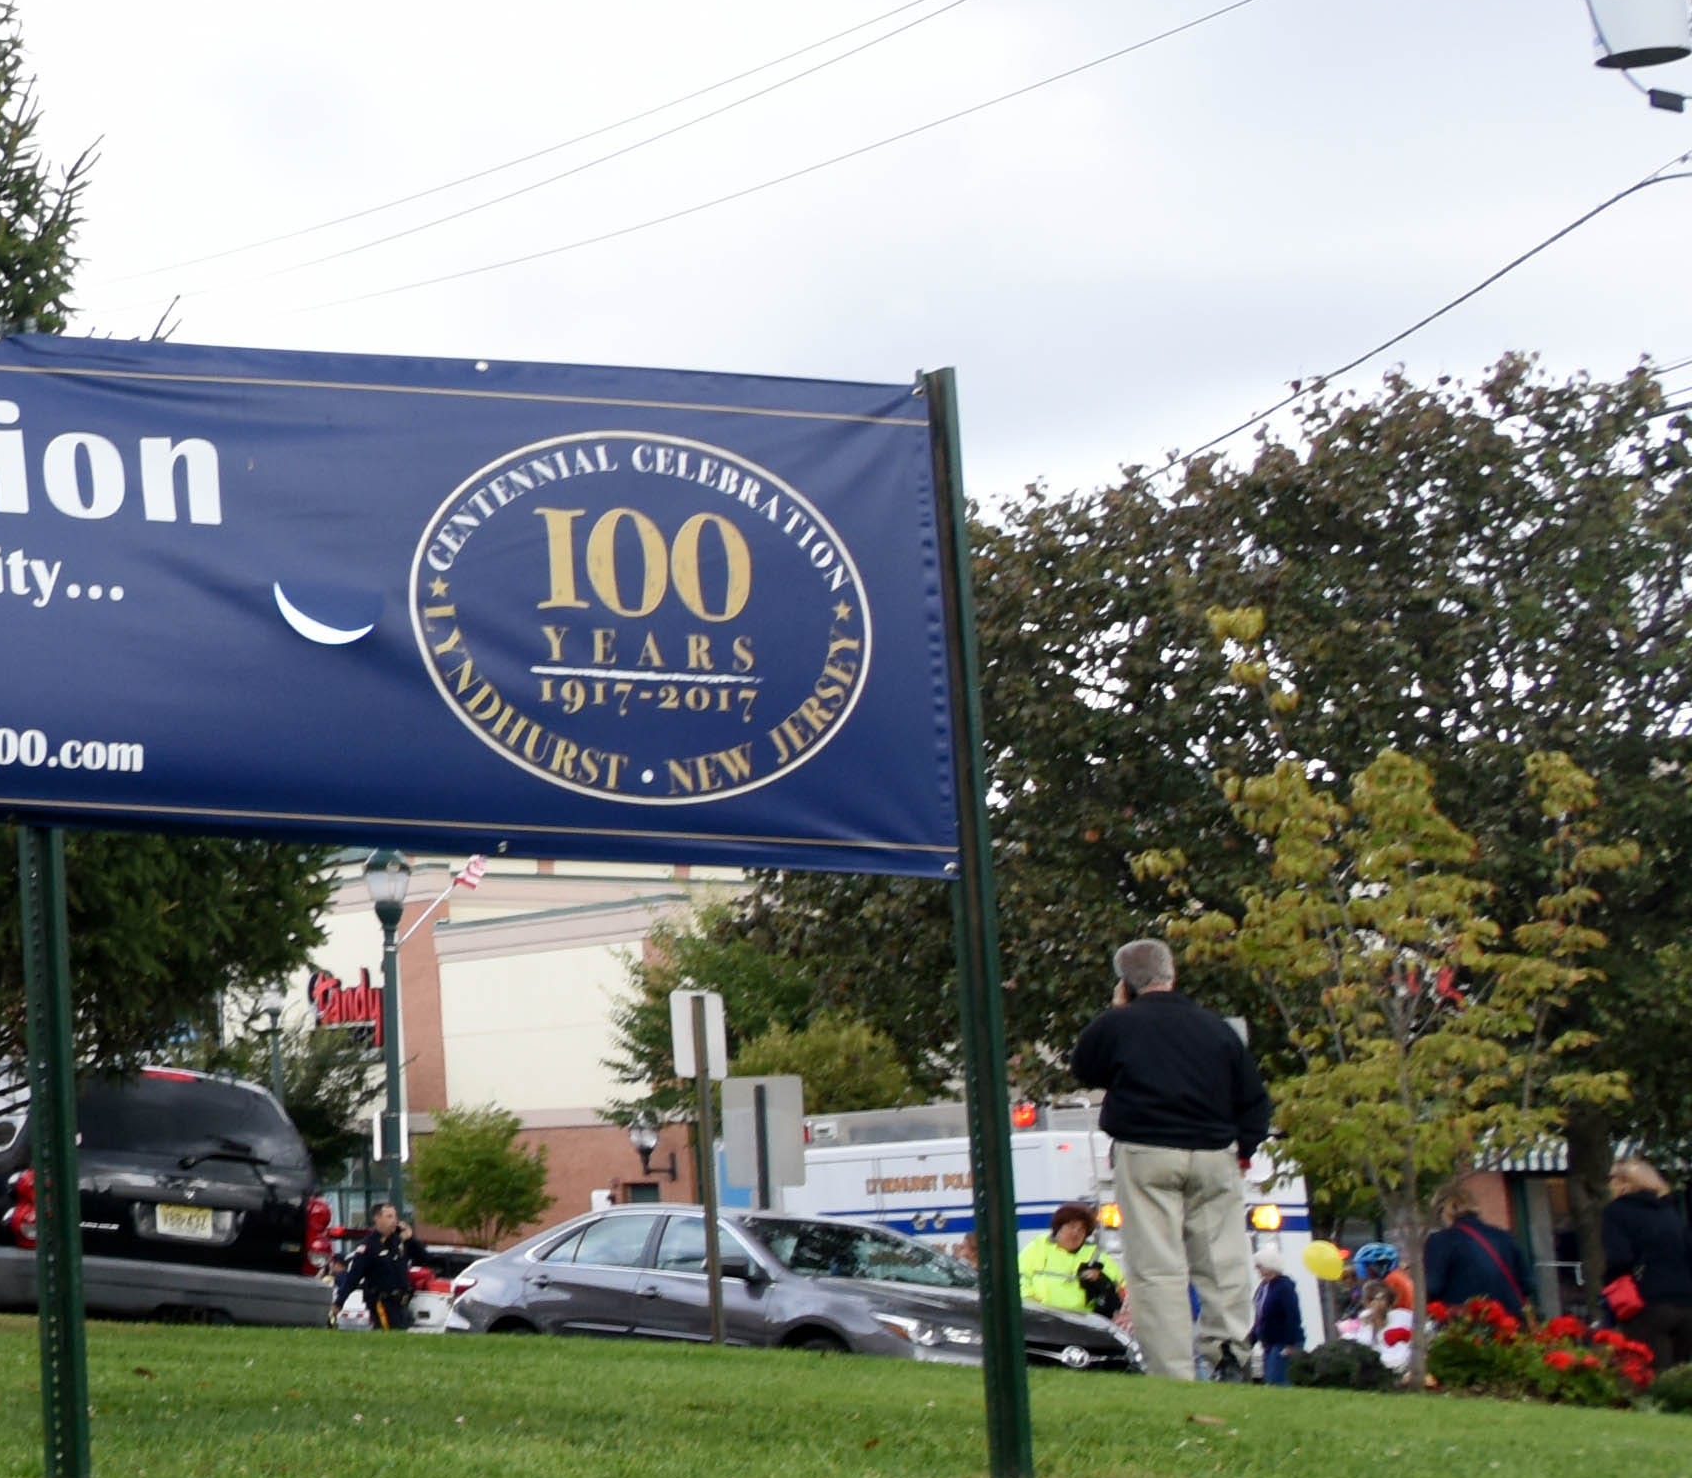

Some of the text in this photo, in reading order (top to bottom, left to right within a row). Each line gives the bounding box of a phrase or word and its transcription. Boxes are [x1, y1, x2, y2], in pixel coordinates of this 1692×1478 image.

[426, 443, 851, 594] CENTENNIAL CELEBRATION
[533, 506, 753, 624] 100
[424, 601, 863, 796] LYNDHURST NEW JERSEY
[538, 676, 759, 723] 1917-2017
[541, 626, 756, 674] YEARS
